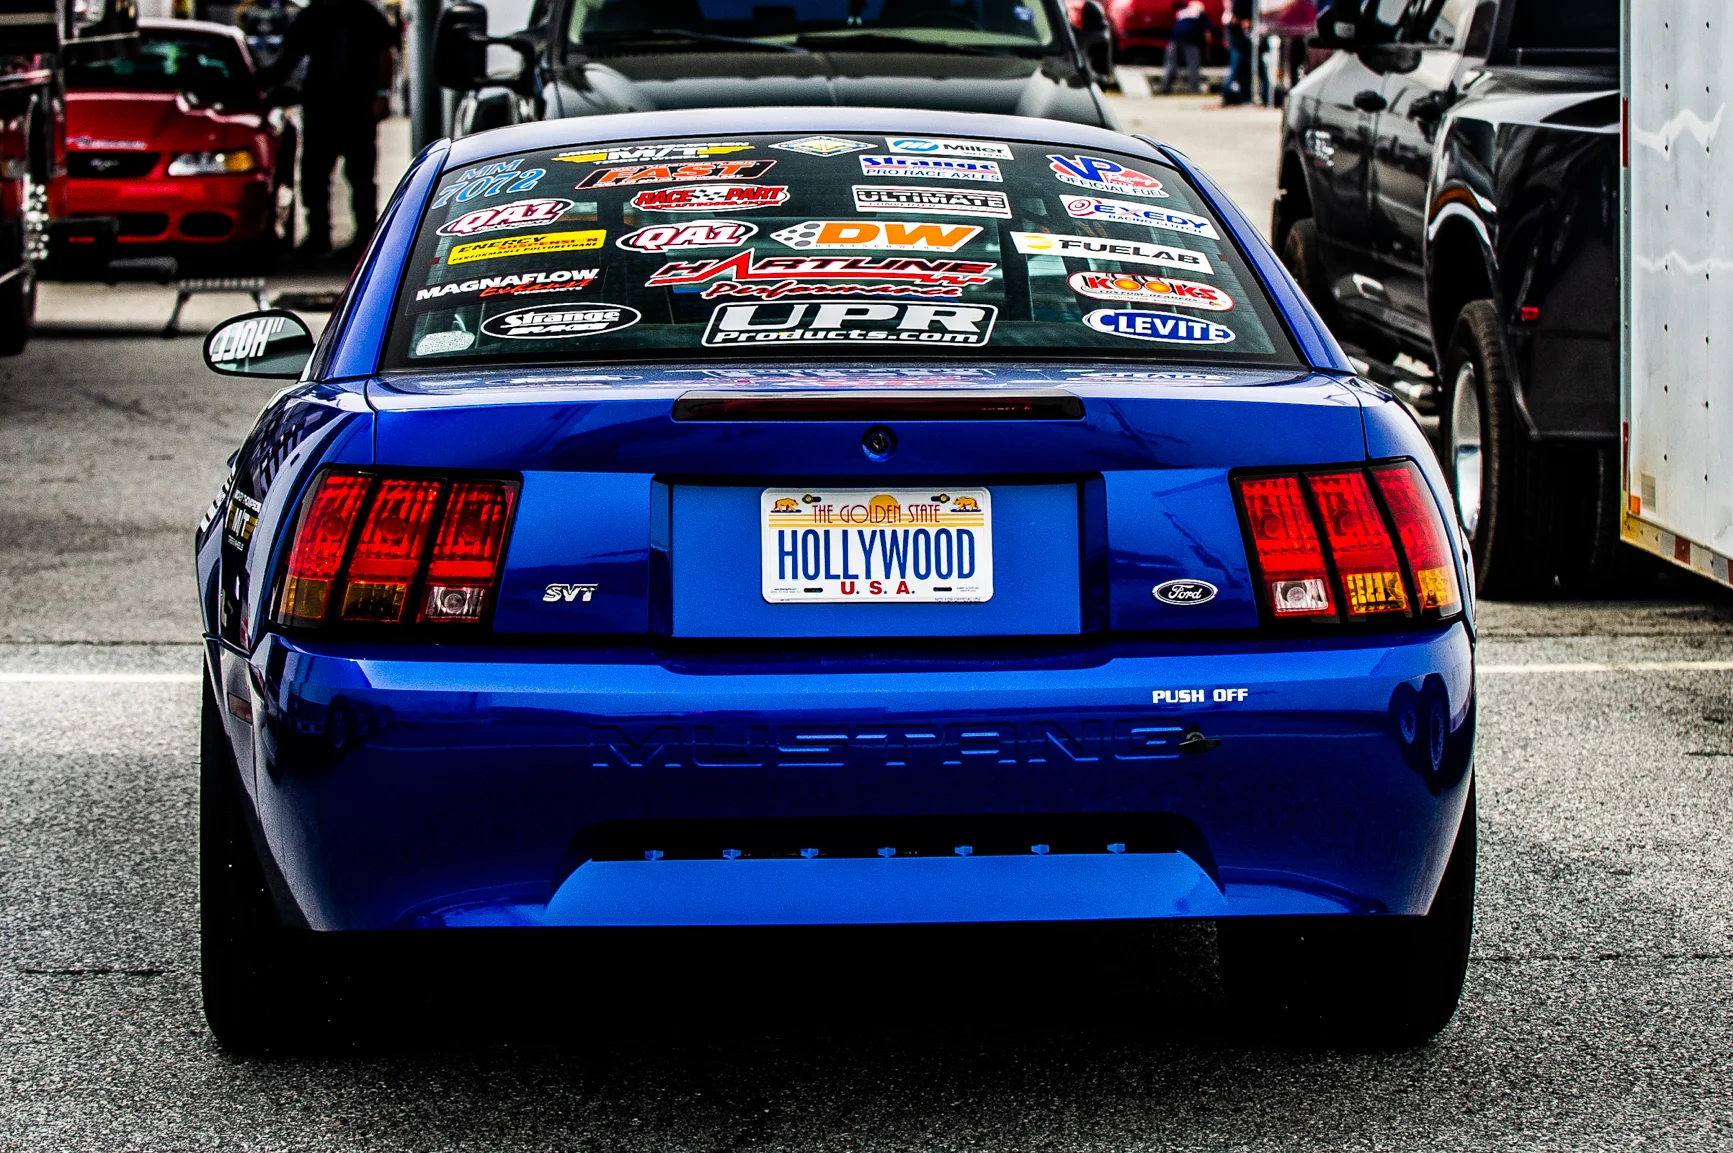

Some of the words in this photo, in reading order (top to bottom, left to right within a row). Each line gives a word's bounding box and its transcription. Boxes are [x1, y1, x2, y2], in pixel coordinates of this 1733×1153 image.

[607, 145, 709, 161] M/T
[942, 143, 1005, 154] Miller
[455, 158, 526, 184] MM
[595, 162, 757, 184] FAST
[862, 156, 996, 171] Strange
[866, 168, 899, 176] PRO
[904, 169, 946, 178] RACE
[950, 172, 1000, 181] AXLES
[1047, 155, 1122, 183] VP
[431, 168, 547, 210] 7072
[636, 189, 695, 206] RACE
[725, 187, 785, 201] PART
[1058, 174, 1130, 194] OFFICIAL
[1132, 187, 1167, 197] FUEL
[856, 190, 1006, 209] ULTIMATE
[449, 200, 560, 235] QA1
[1094, 203, 1208, 229] EXEDY
[1108, 214, 1153, 225] RACING
[1156, 222, 1203, 234] CLUTCH
[458, 235, 548, 254] ENERGY
[498, 236, 599, 251] SUSPENSION
[633, 224, 742, 251] QA1
[816, 222, 977, 247] DW
[523, 242, 598, 252] POLYURETHANE
[1058, 239, 1201, 265] FUELAB
[645, 248, 997, 287] HARTLINE
[415, 268, 601, 301] MAGNAFLOW
[700, 279, 963, 301] Performance
[1082, 273, 1219, 301] KOOKS
[1099, 289, 1145, 297] CUSTOM
[500, 308, 622, 329] Strange
[718, 303, 982, 333] UPR
[1088, 309, 1229, 343] CLEVITE
[711, 330, 979, 345] Products.com
[811, 504, 834, 524] THE
[839, 504, 902, 524] GOLDEN
[908, 504, 941, 523] STATE
[777, 528, 976, 581] HOLLYWOOD
[542, 582, 599, 602] SVT
[1168, 583, 1204, 600] Ford
[1151, 689, 1205, 704] PUSH
[1213, 688, 1249, 702] OFF
[592, 720, 1186, 769] MUSTANG
